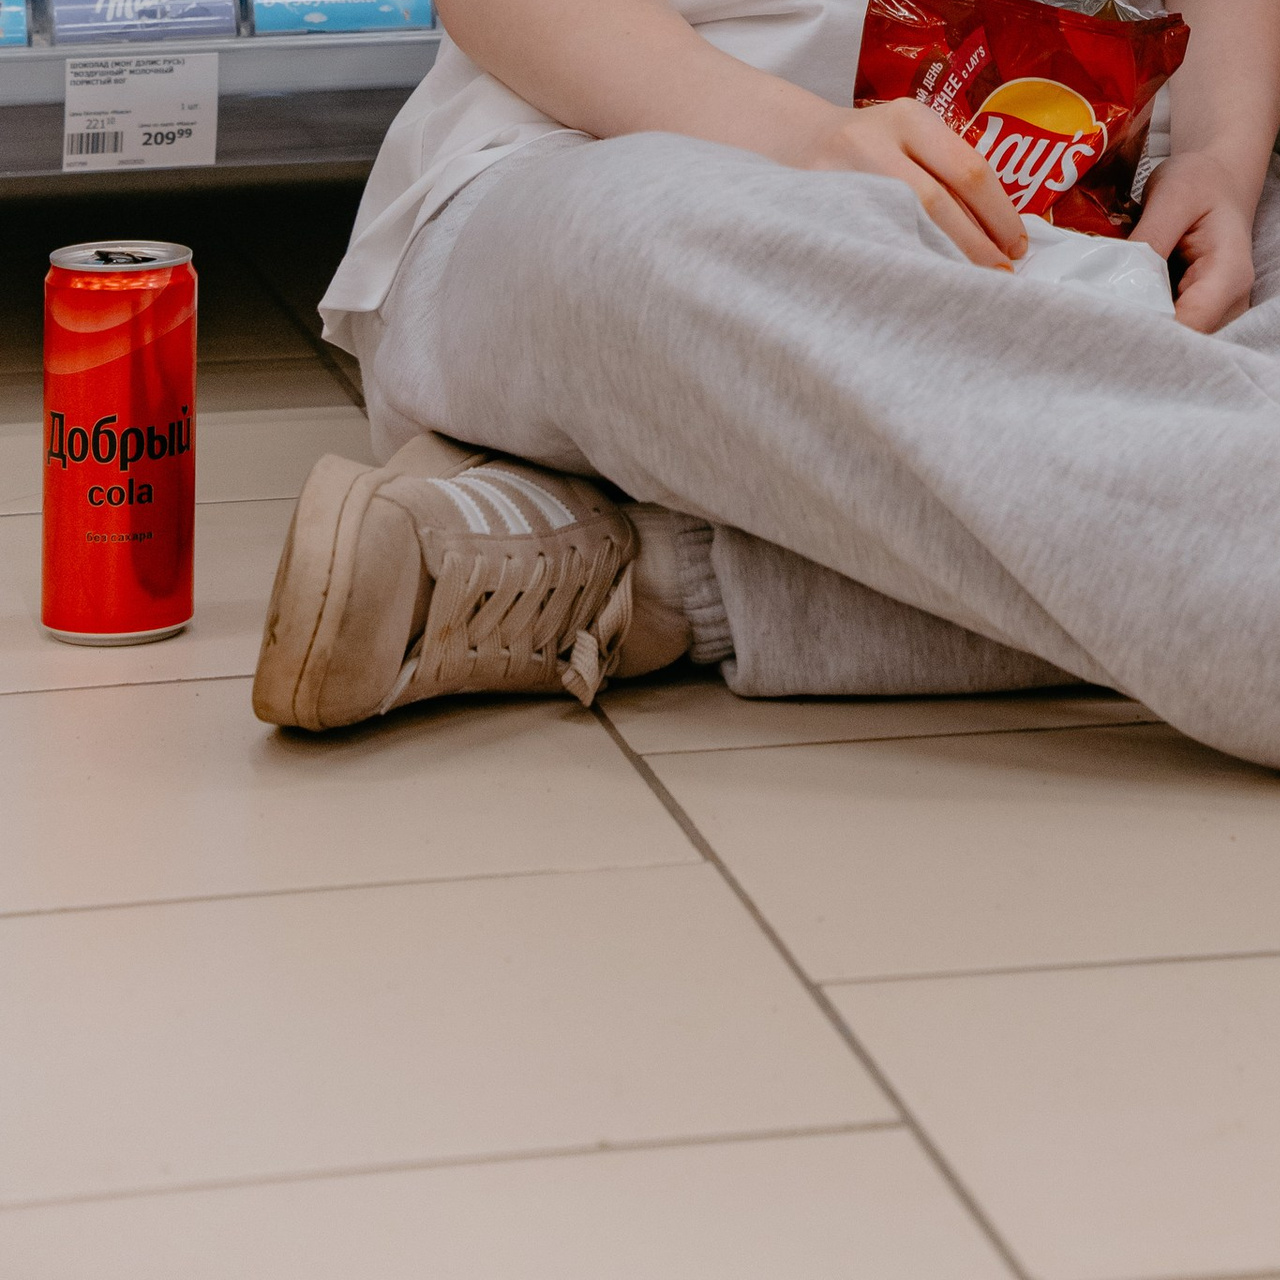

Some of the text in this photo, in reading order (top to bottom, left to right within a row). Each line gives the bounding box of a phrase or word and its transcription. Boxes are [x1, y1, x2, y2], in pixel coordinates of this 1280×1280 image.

[70, 61, 109, 70] ШОКОЛАД
[129, 66, 174, 75] МОЛОЧНЫЙ
[965, 45, 986, 73] LAY'S
[922, 62, 944, 92] ДЕНЬ
[47, 404, 193, 471] Добрый
[87, 478, 154, 508] cola
[85, 528, 154, 545] без сахара
